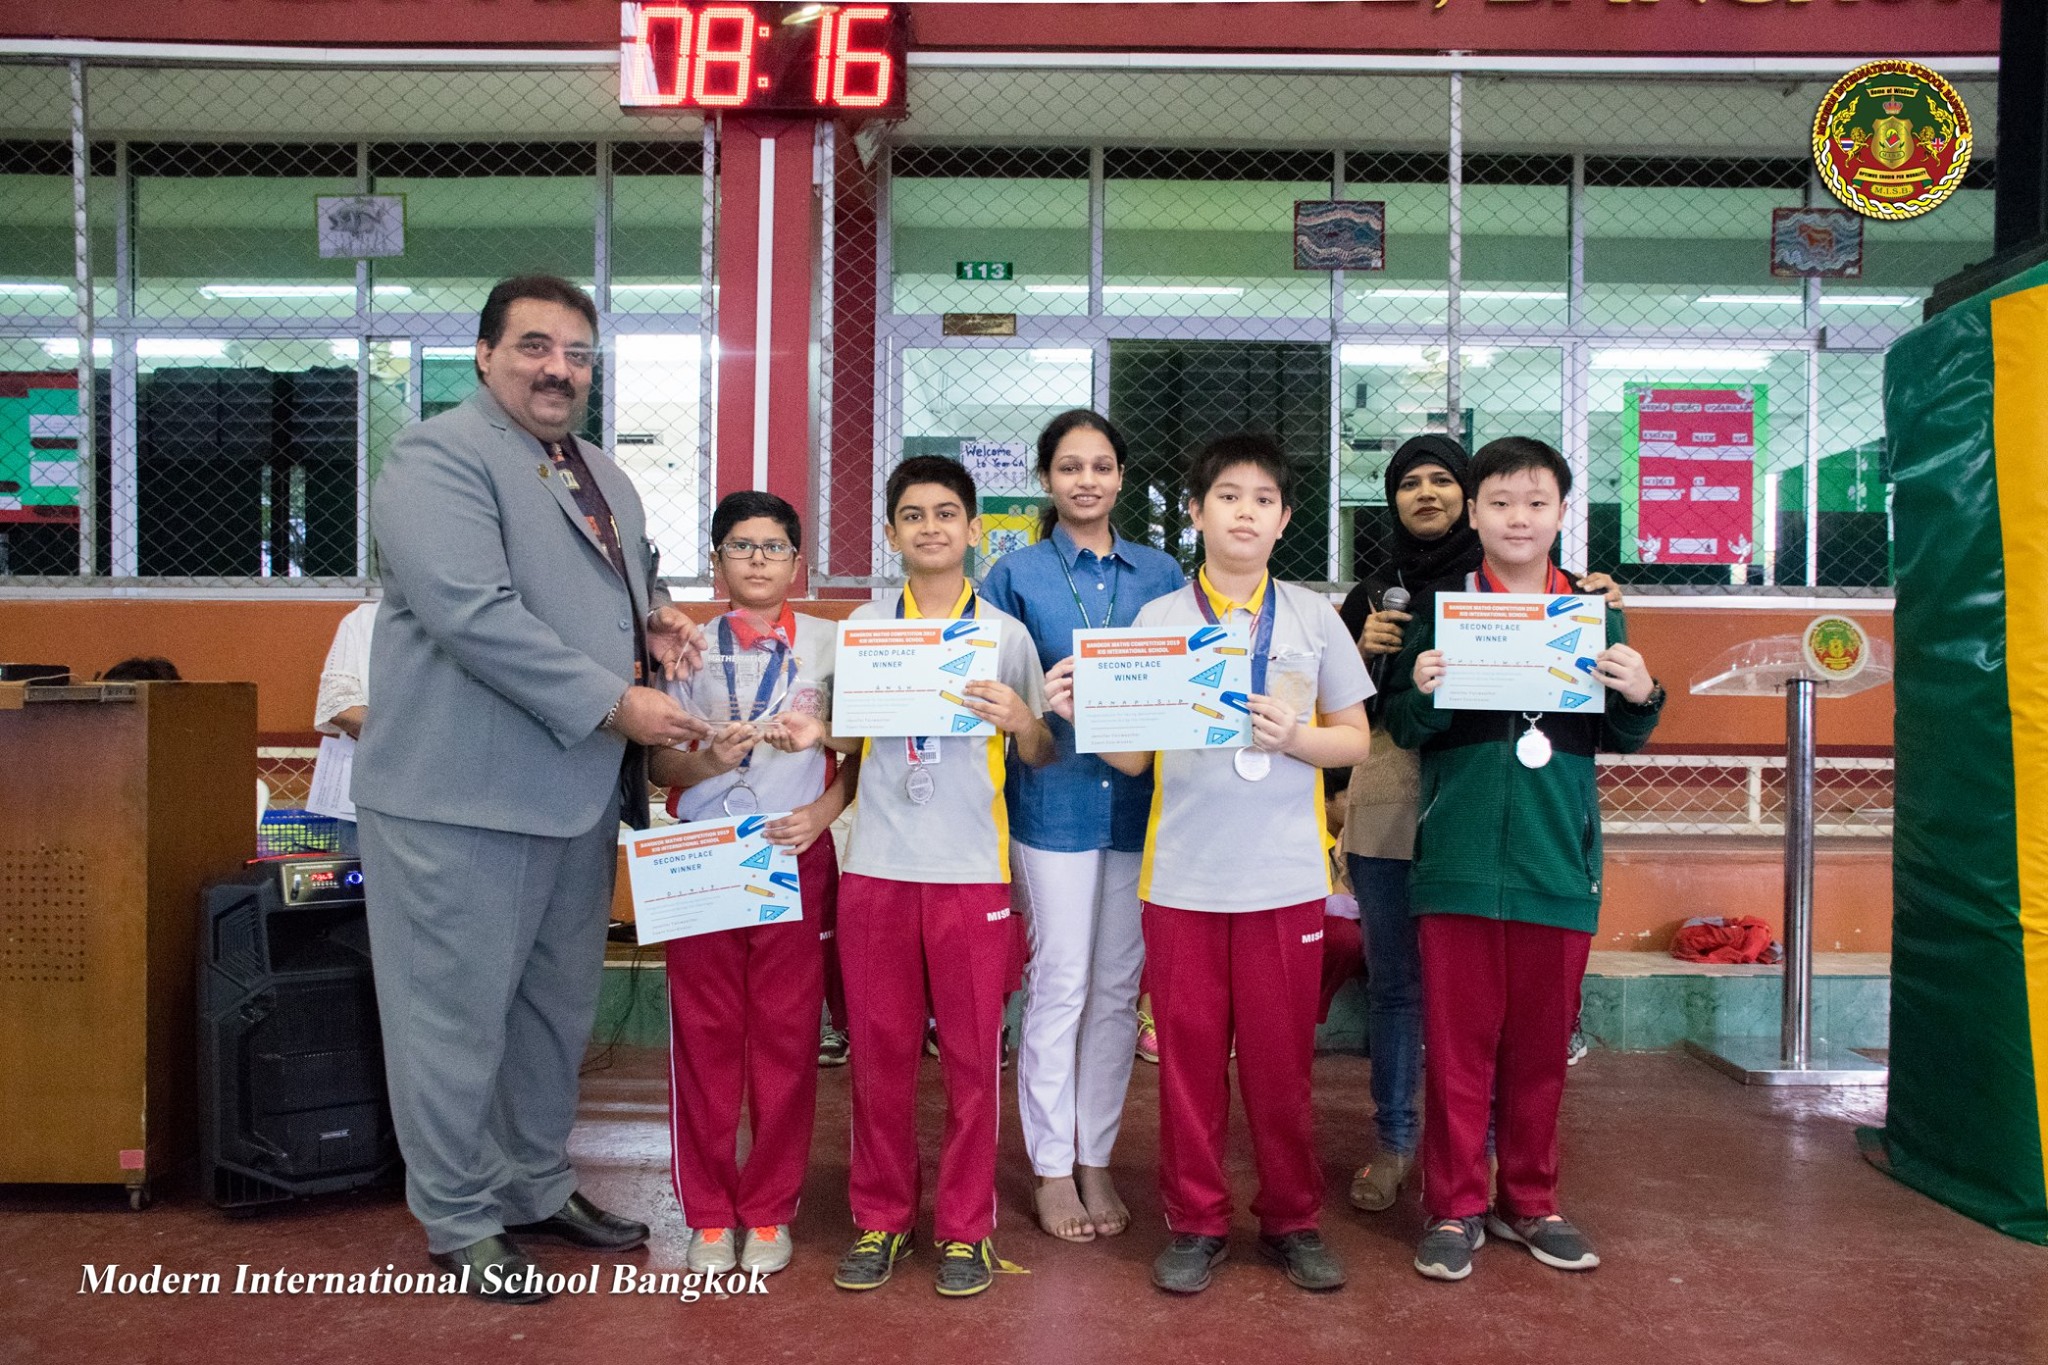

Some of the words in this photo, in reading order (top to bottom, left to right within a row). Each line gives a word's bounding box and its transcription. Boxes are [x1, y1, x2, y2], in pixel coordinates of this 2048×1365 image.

[963, 263, 1005, 279] 113
[965, 444, 1012, 457] Welcome
[976, 458, 987, 469] to
[992, 457, 1011, 468] Year
[1460, 623, 1493, 631] SECOND
[858, 649, 890, 657] SECOND
[1097, 661, 1132, 670] SECOND
[1134, 660, 1161, 668] PLACE
[1114, 673, 1149, 682] WINNER
[653, 854, 686, 866] SECOND
[688, 850, 713, 859] PLACE
[670, 863, 702, 875] WINNER
